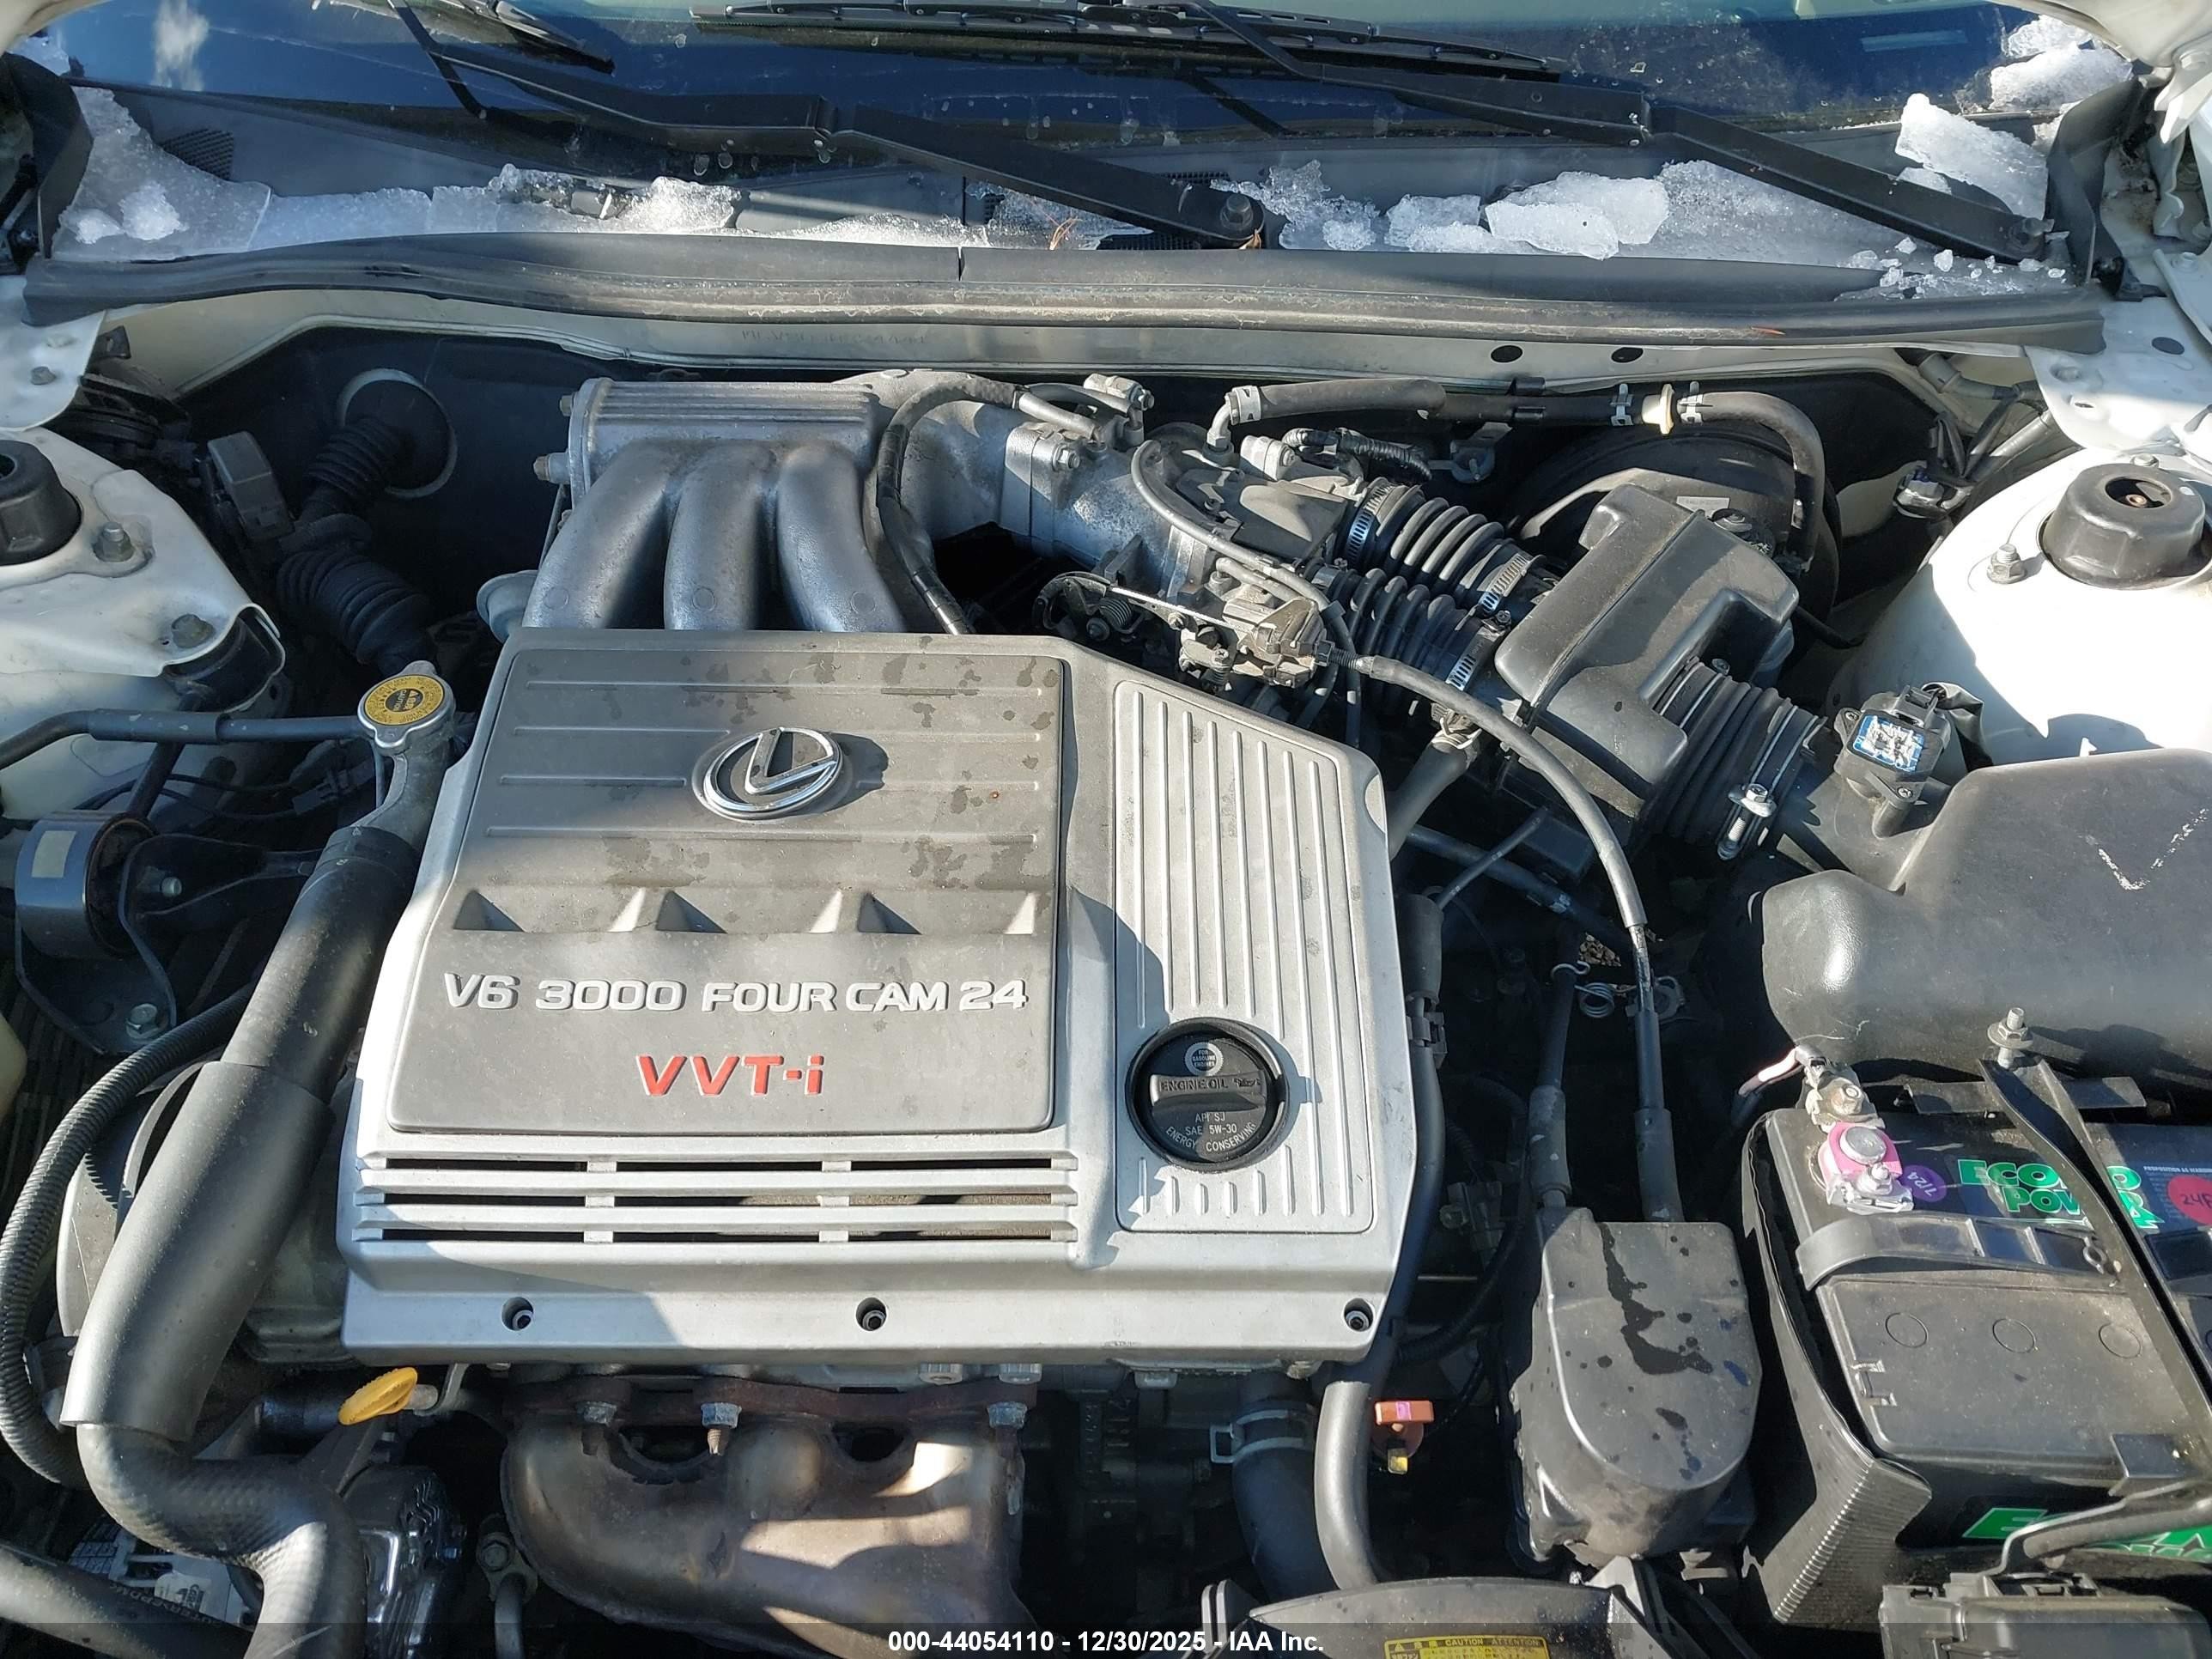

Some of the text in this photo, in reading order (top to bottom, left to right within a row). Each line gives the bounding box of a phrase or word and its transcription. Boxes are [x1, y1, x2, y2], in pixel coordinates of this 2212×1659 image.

[443, 971, 1029, 1012] V6 3000 FOUR CAM 24
[635, 1053, 825, 1097] VVT-i
[1159, 1078, 1228, 1091] ENGINE OIL
[1194, 1111, 1225, 1123] API SJ
[1185, 1123, 1237, 1136] SAE 5W-30
[1165, 1121, 1257, 1152] ENERGY CONSERVING
[1445, 1638, 1484, 1647] CAUTION
[1491, 1638, 1540, 1647] ATTENTION
